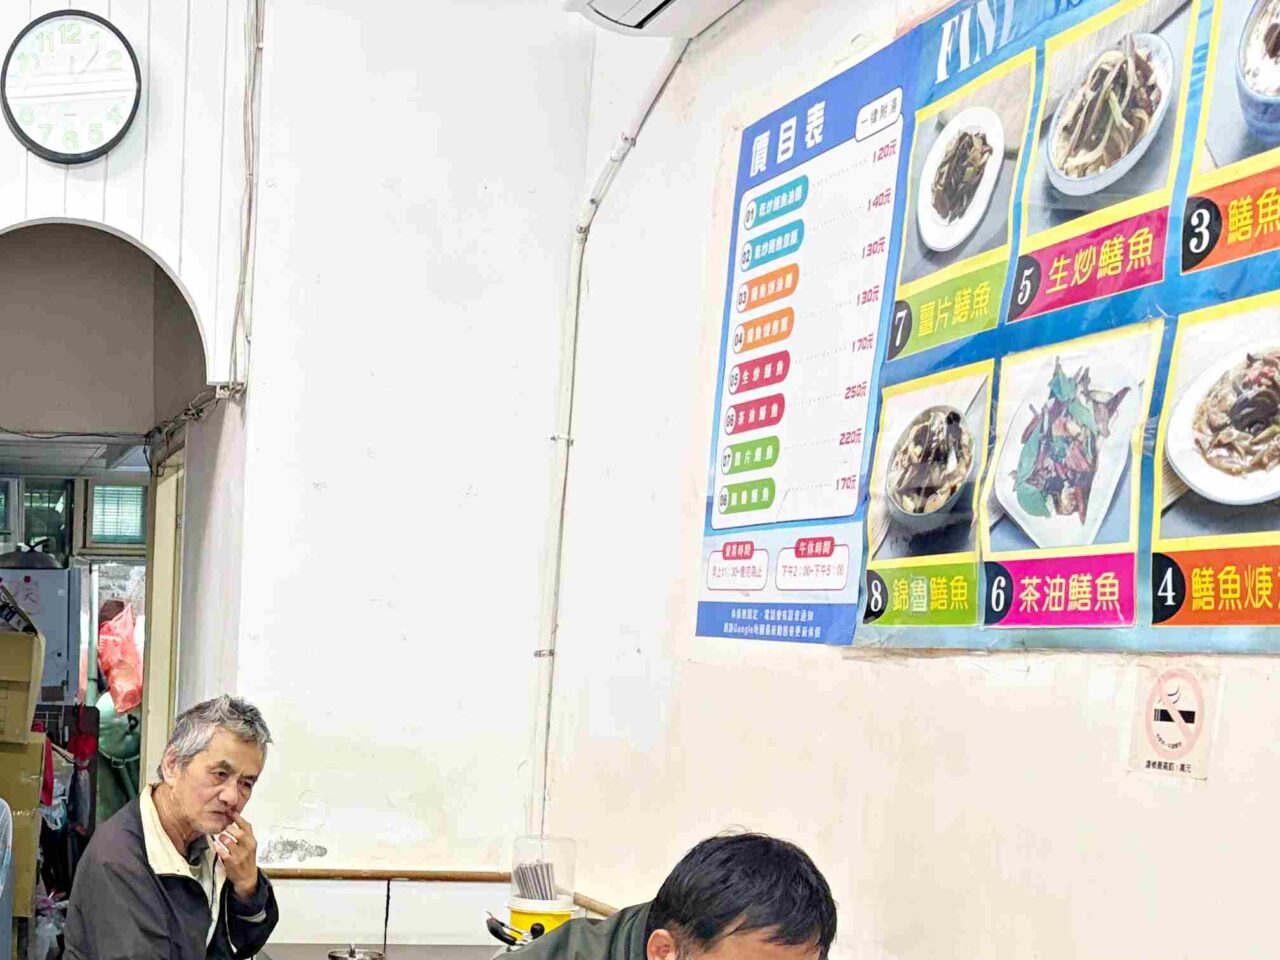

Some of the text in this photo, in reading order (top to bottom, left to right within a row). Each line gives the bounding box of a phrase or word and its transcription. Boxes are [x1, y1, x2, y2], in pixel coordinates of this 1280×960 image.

[36, 31, 55, 53] 11
[58, 23, 82, 44] 12
[106, 50, 122, 70] 2
[19, 104, 35, 125] 8
[106, 104, 122, 124] 4
[38, 124, 53, 144] 7
[88, 123, 103, 144] 5
[750, 100, 826, 178] 價目表
[872, 139, 897, 163] 120元
[868, 187, 892, 211] 140元
[1189, 208, 1211, 253] 3
[862, 236, 886, 259] 130元
[1018, 227, 1153, 305] 5 生炒鱔魚
[857, 285, 880, 306] 130元
[895, 281, 991, 347] 7 薑片鱔魚
[852, 333, 874, 352] 170元
[844, 381, 868, 400] 250元
[839, 428, 862, 446] 220元
[836, 474, 857, 490] 170元
[798, 540, 832, 555] 午休時間
[870, 579, 882, 612] 8
[991, 572, 1120, 612] 6 茶油鱔魚
[1157, 567, 1176, 605] 4
